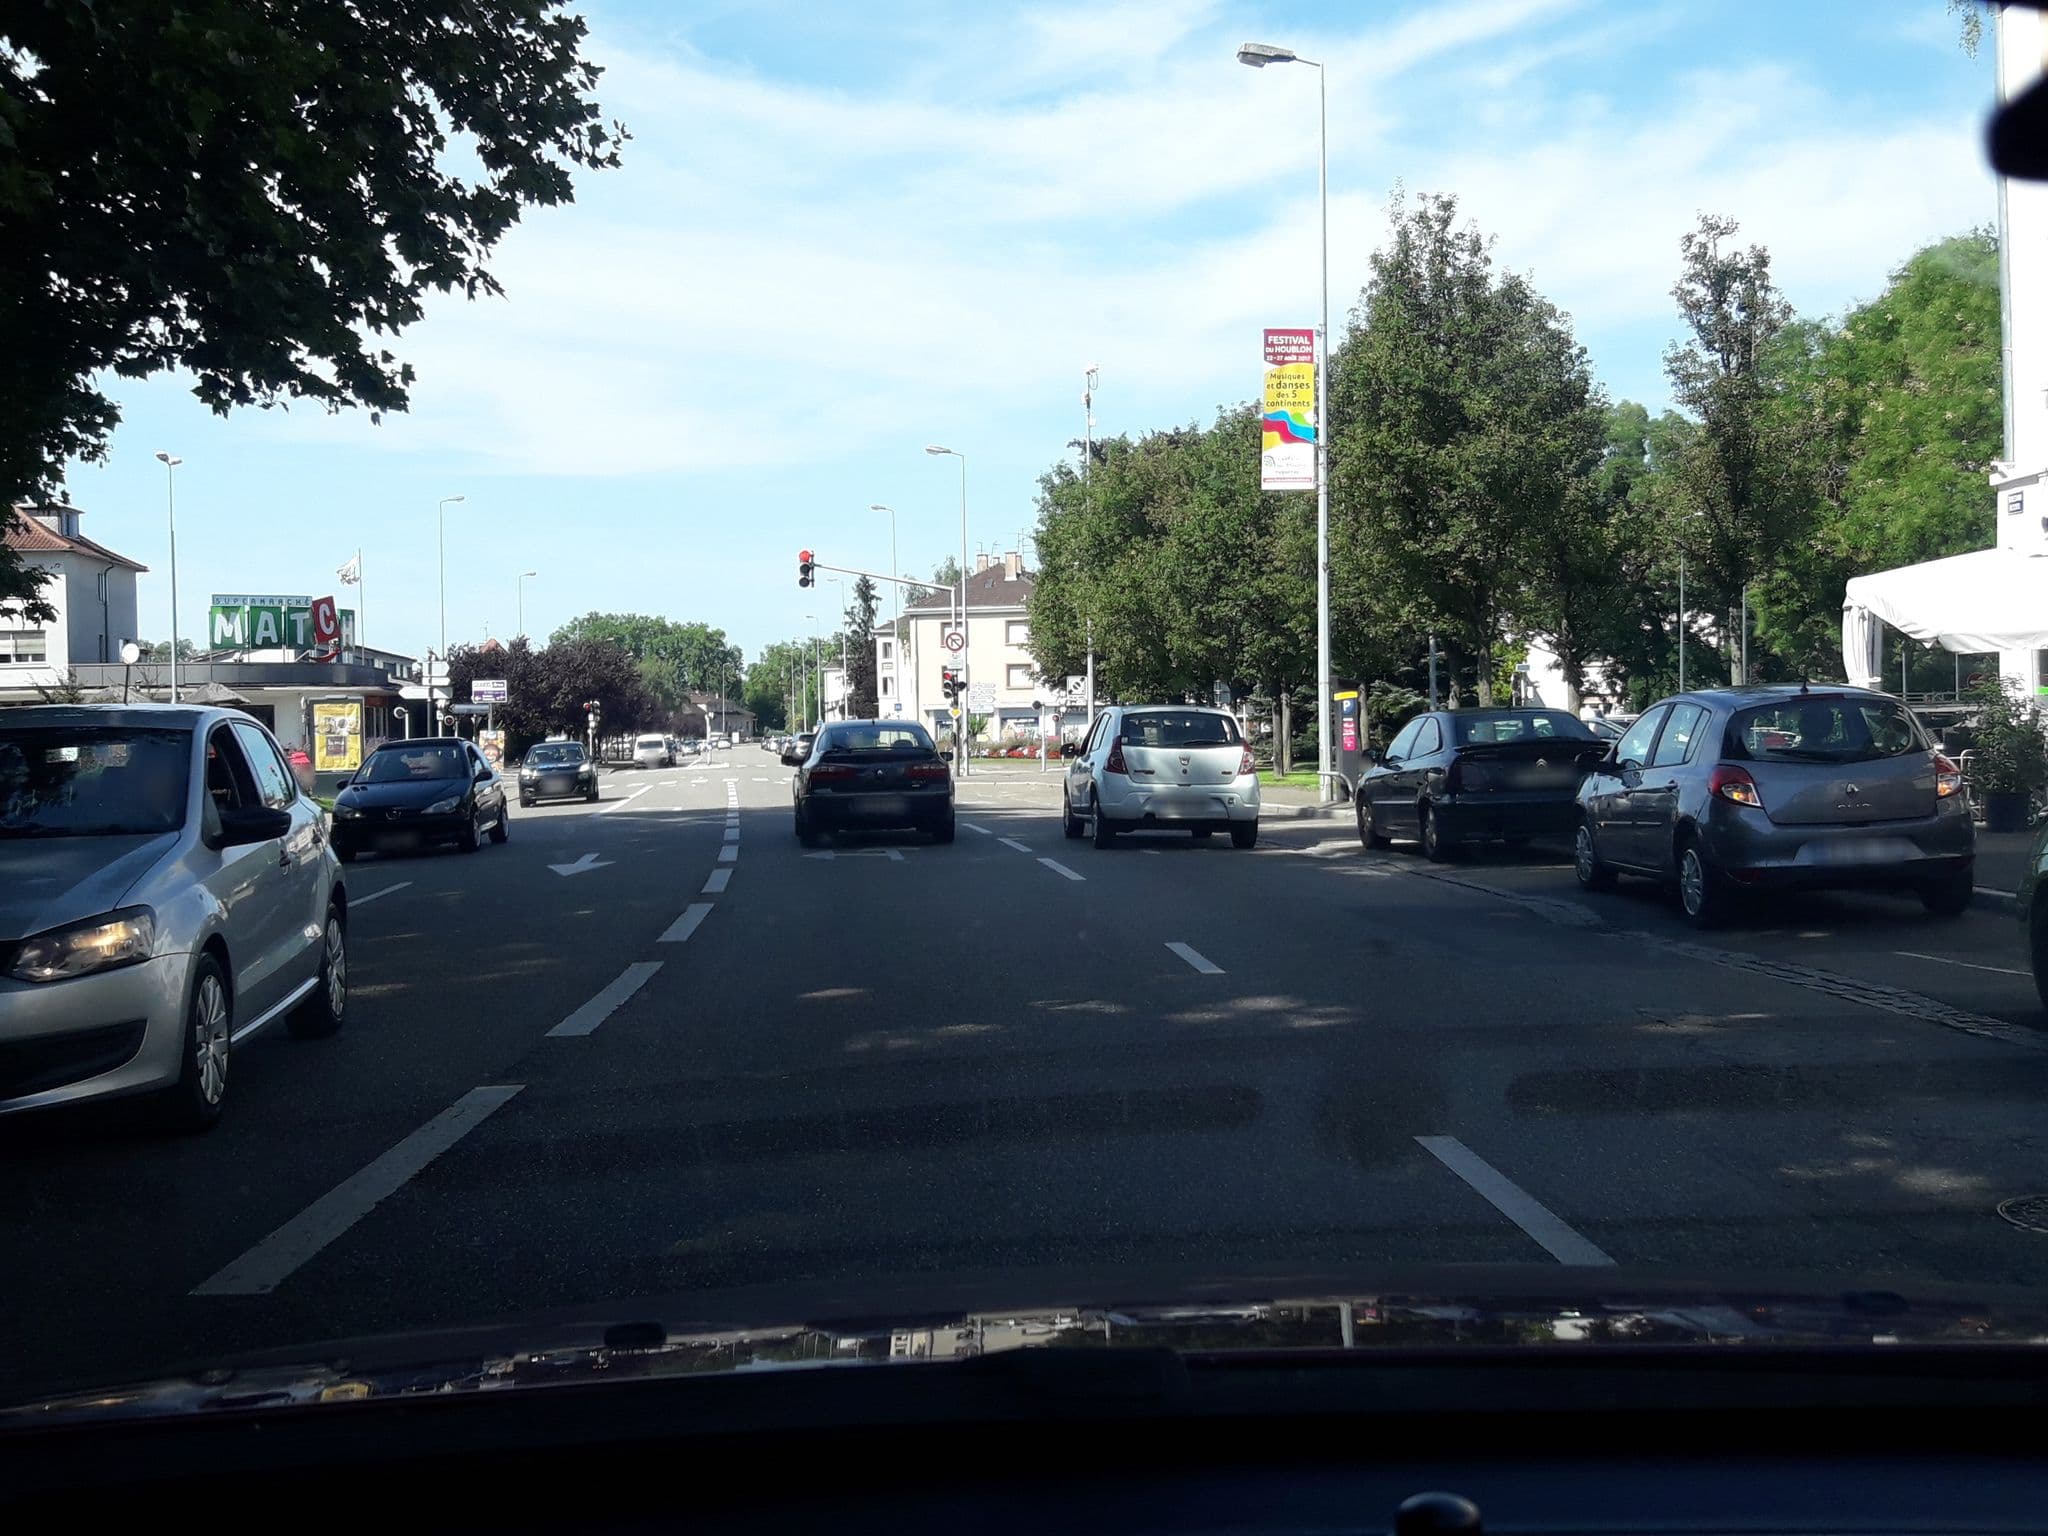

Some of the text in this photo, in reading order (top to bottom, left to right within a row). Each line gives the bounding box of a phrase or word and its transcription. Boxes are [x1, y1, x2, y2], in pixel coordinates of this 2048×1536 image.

[1268, 336, 1310, 344] FESTIVAL
[1276, 380, 1310, 389] danses
[1292, 390, 1297, 398] 5
[214, 596, 311, 606] SUPERMARCHÉ
[214, 603, 352, 646] MATCH
[1343, 700, 1351, 712] P
